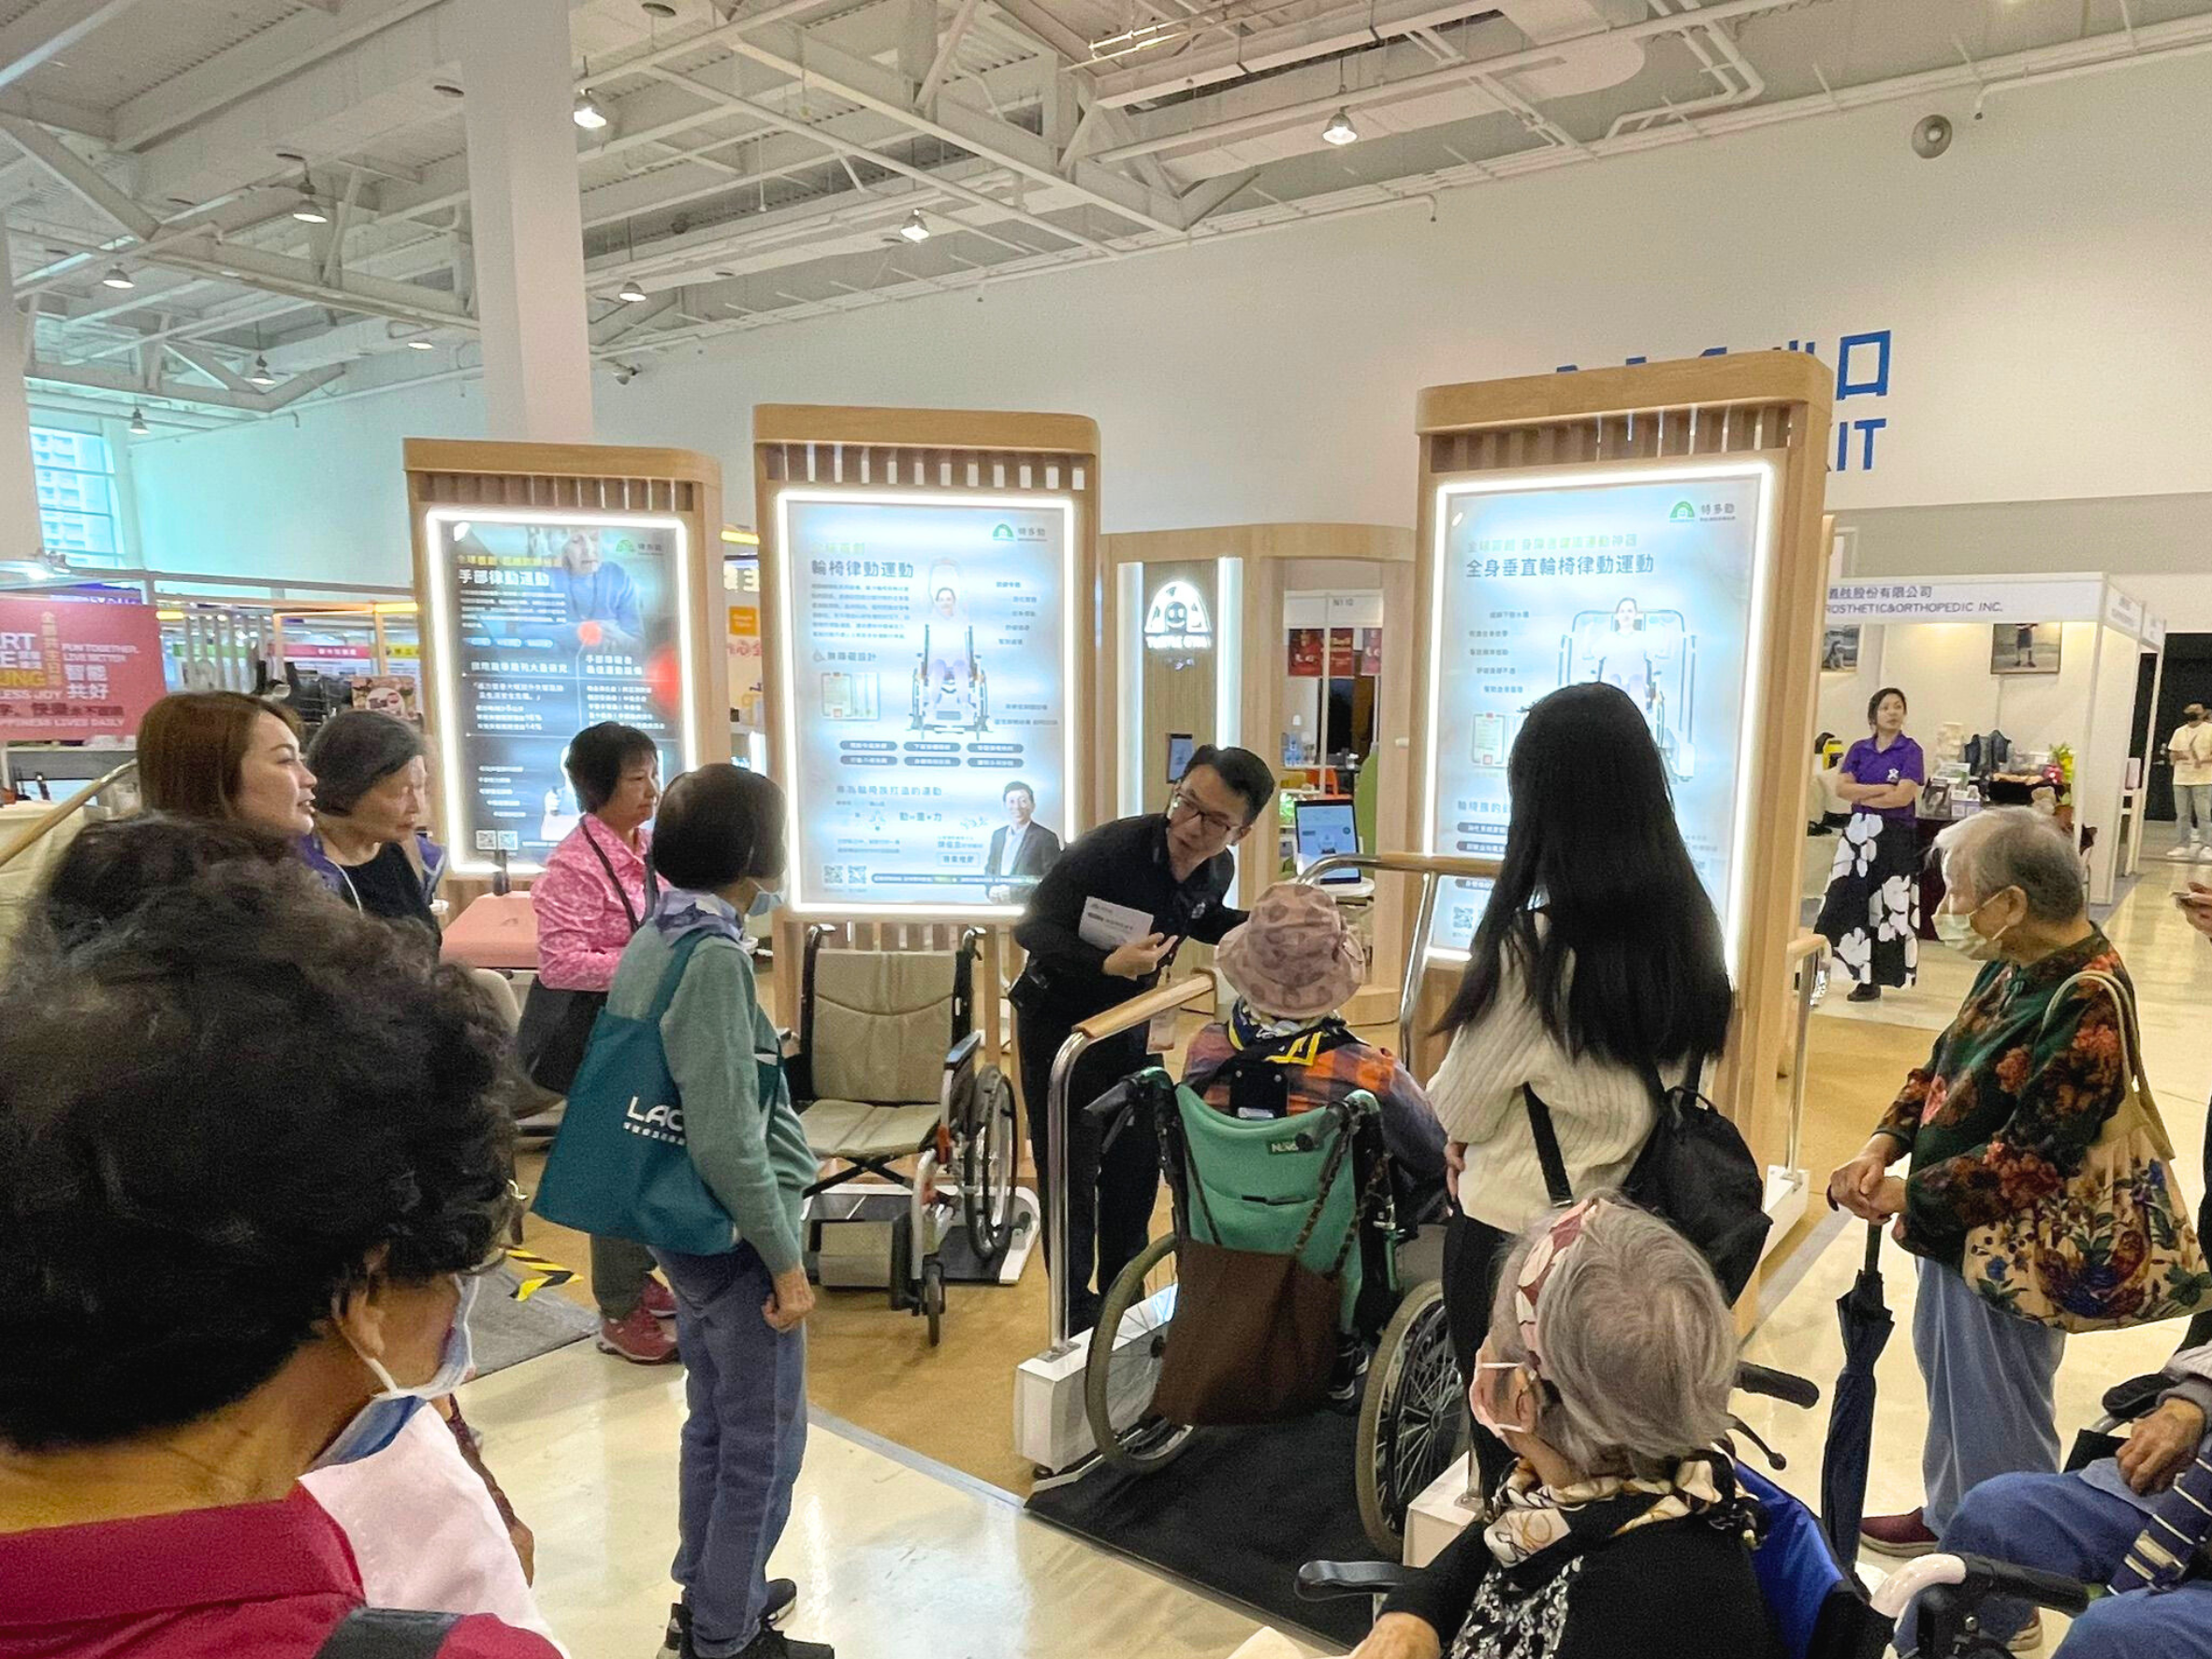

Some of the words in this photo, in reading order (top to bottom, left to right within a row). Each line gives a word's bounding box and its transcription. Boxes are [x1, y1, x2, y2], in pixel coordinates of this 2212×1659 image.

[1836, 418, 1886, 472] IT
[811, 560, 913, 578] 輪椅律動運動
[1466, 553, 1654, 578] 全身垂直輪椅律動運動
[458, 569, 550, 587] 手部律動運動
[0, 633, 36, 650] RT
